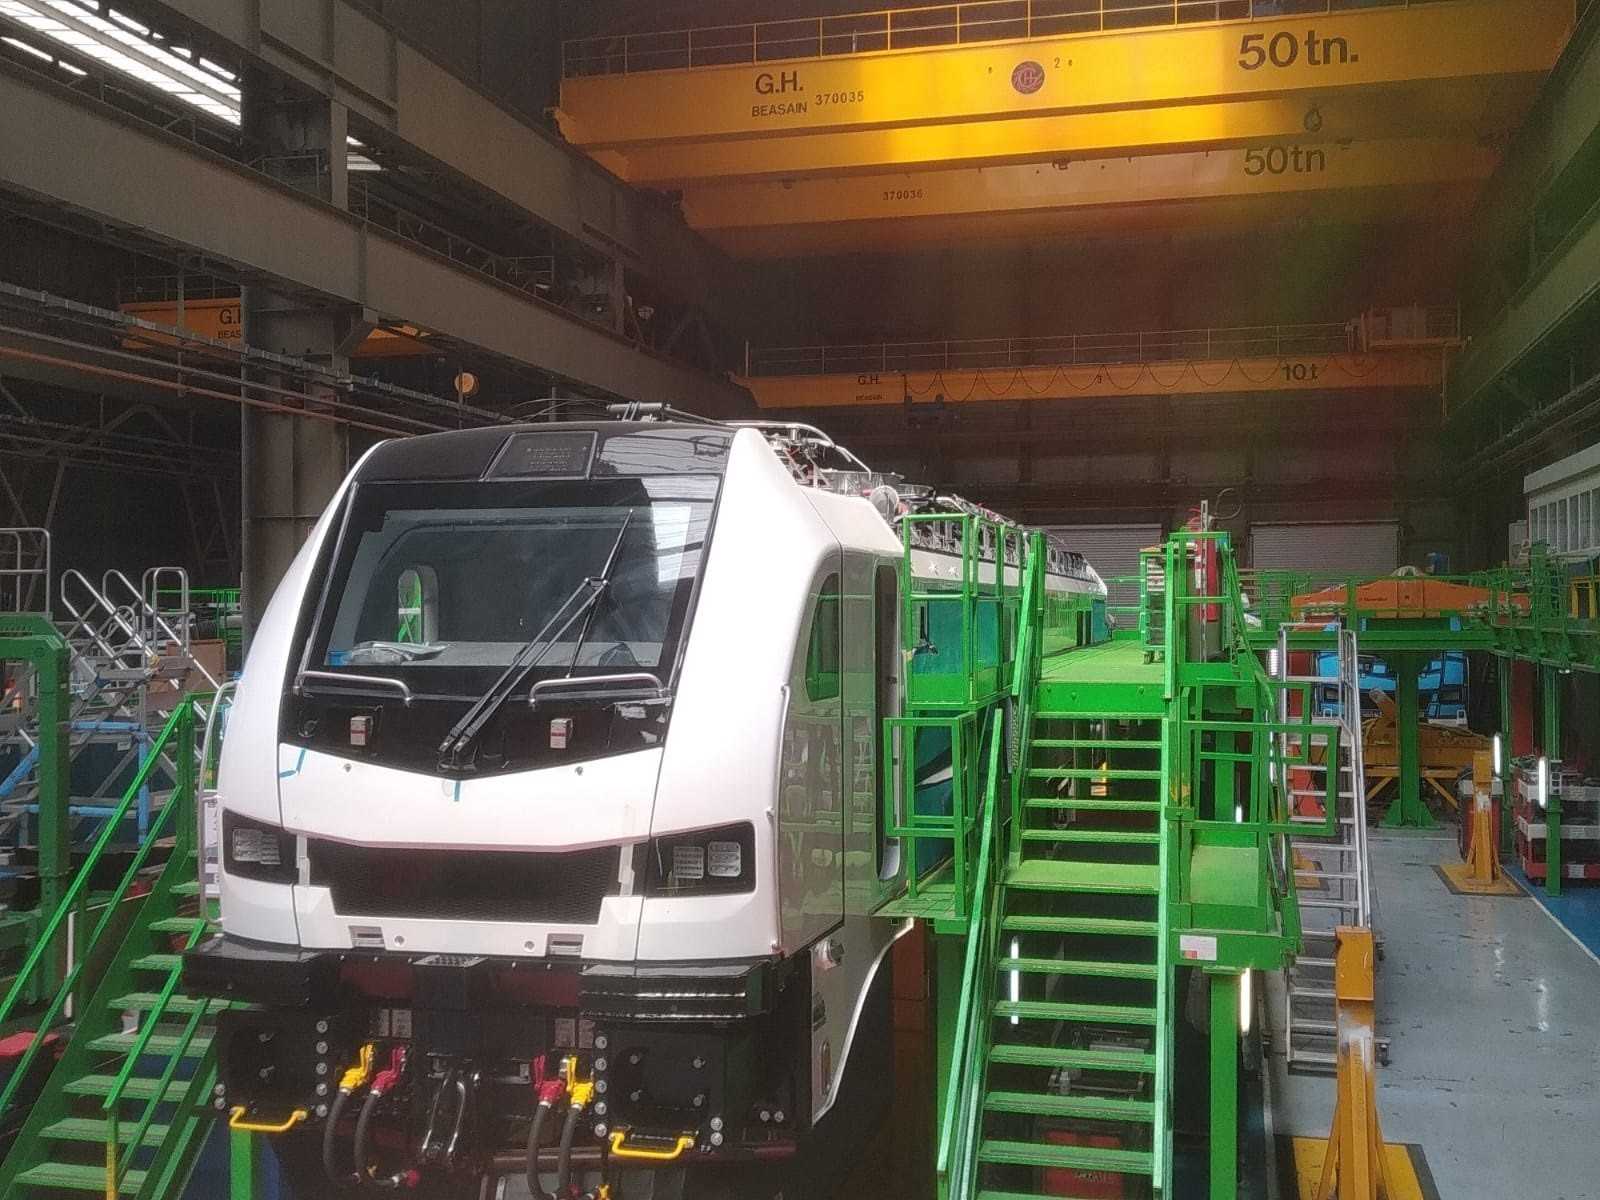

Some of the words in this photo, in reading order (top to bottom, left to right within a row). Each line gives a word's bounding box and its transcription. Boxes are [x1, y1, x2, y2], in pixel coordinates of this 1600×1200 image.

[1054, 57, 1061, 68] 2
[755, 71, 804, 94] G.H.
[815, 91, 864, 105] 370035
[752, 103, 807, 117] BEASAIN
